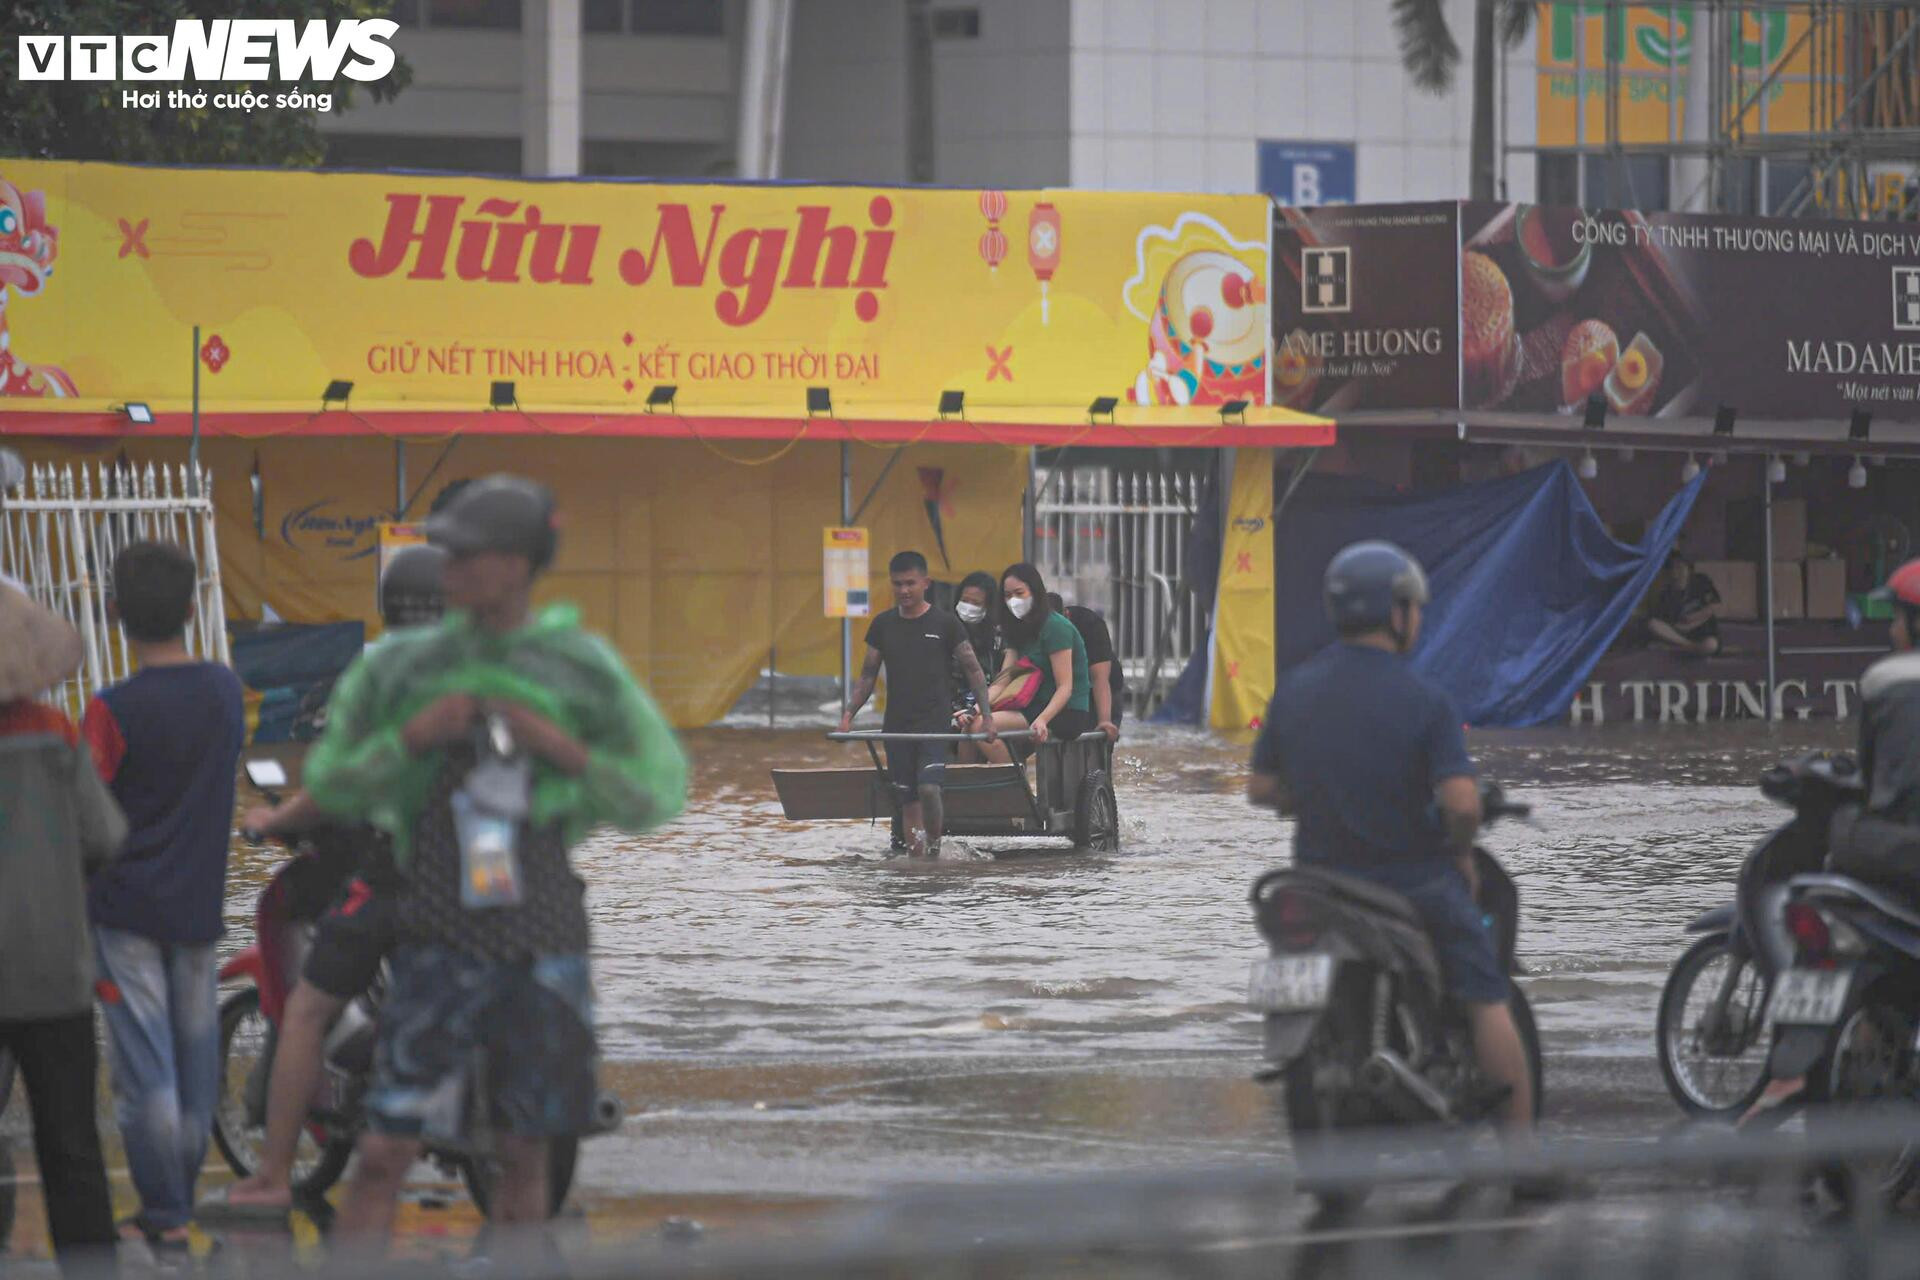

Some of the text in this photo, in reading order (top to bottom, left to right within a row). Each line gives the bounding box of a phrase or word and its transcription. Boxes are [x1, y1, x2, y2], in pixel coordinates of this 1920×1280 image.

[1293, 165, 1319, 206] B
[1571, 216, 1627, 245] CÔNG
[1632, 223, 1653, 246] TY
[1660, 224, 1708, 249] TNHH
[1713, 227, 1794, 252] THƯƠNG
[1799, 231, 1830, 257] MẠI
[1834, 228, 1860, 254] VÀ
[1863, 233, 1905, 259] DỊCH
[348, 193, 895, 327] Hữu Nghị
[367, 340, 423, 374] GIỮ
[427, 342, 476, 375] NÉT
[482, 348, 549, 377] TINH
[556, 350, 616, 378] HOA
[638, 344, 680, 379] KẾT
[687, 352, 755, 380] GIAO
[762, 346, 829, 380] THỜI
[1271, 327, 1442, 357] AME HUONG
[1786, 339, 1920, 375] MADAME
[1620, 680, 1811, 723] TRUNG
